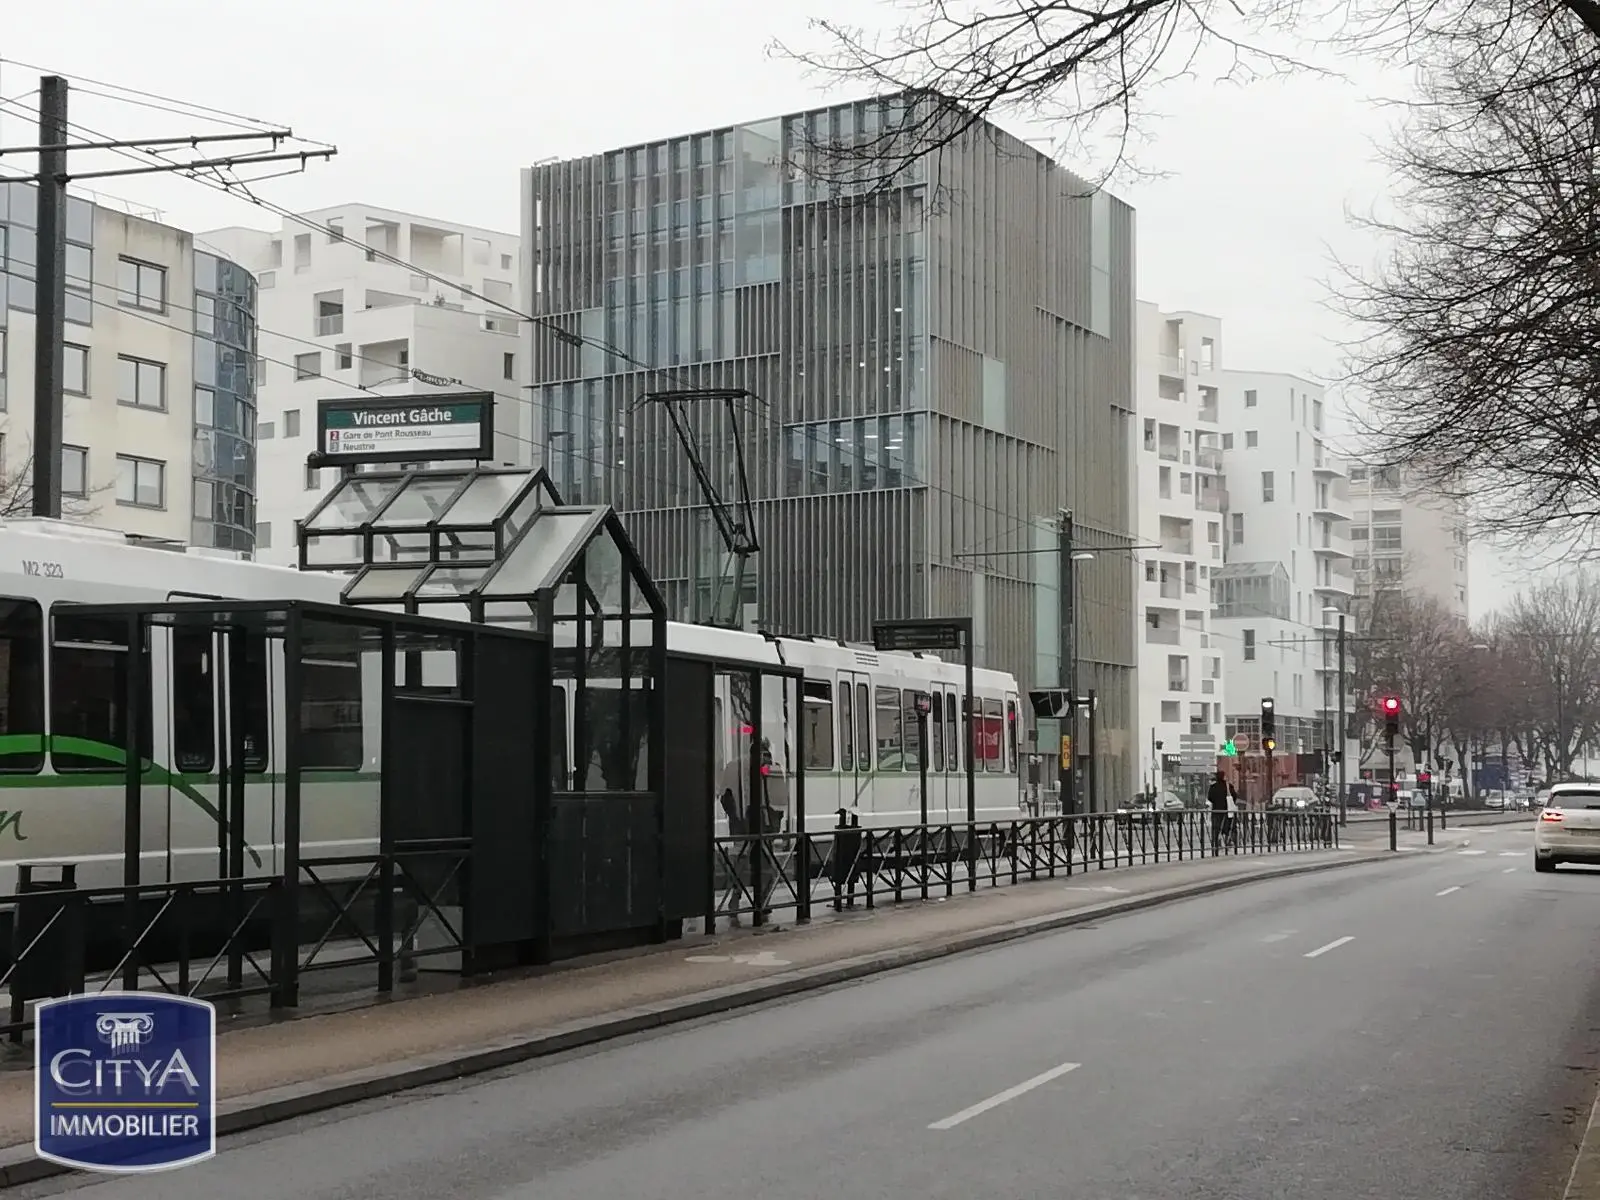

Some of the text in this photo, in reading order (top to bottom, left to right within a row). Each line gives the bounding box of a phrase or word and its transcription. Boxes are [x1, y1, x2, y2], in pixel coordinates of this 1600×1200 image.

[352, 407, 452, 425] Vincent Gâche
[343, 431, 362, 440] Gare
[363, 431, 373, 440] de
[375, 430, 393, 439] Pont
[395, 429, 432, 438] Rousseau
[22, 560, 64, 578] M2 323
